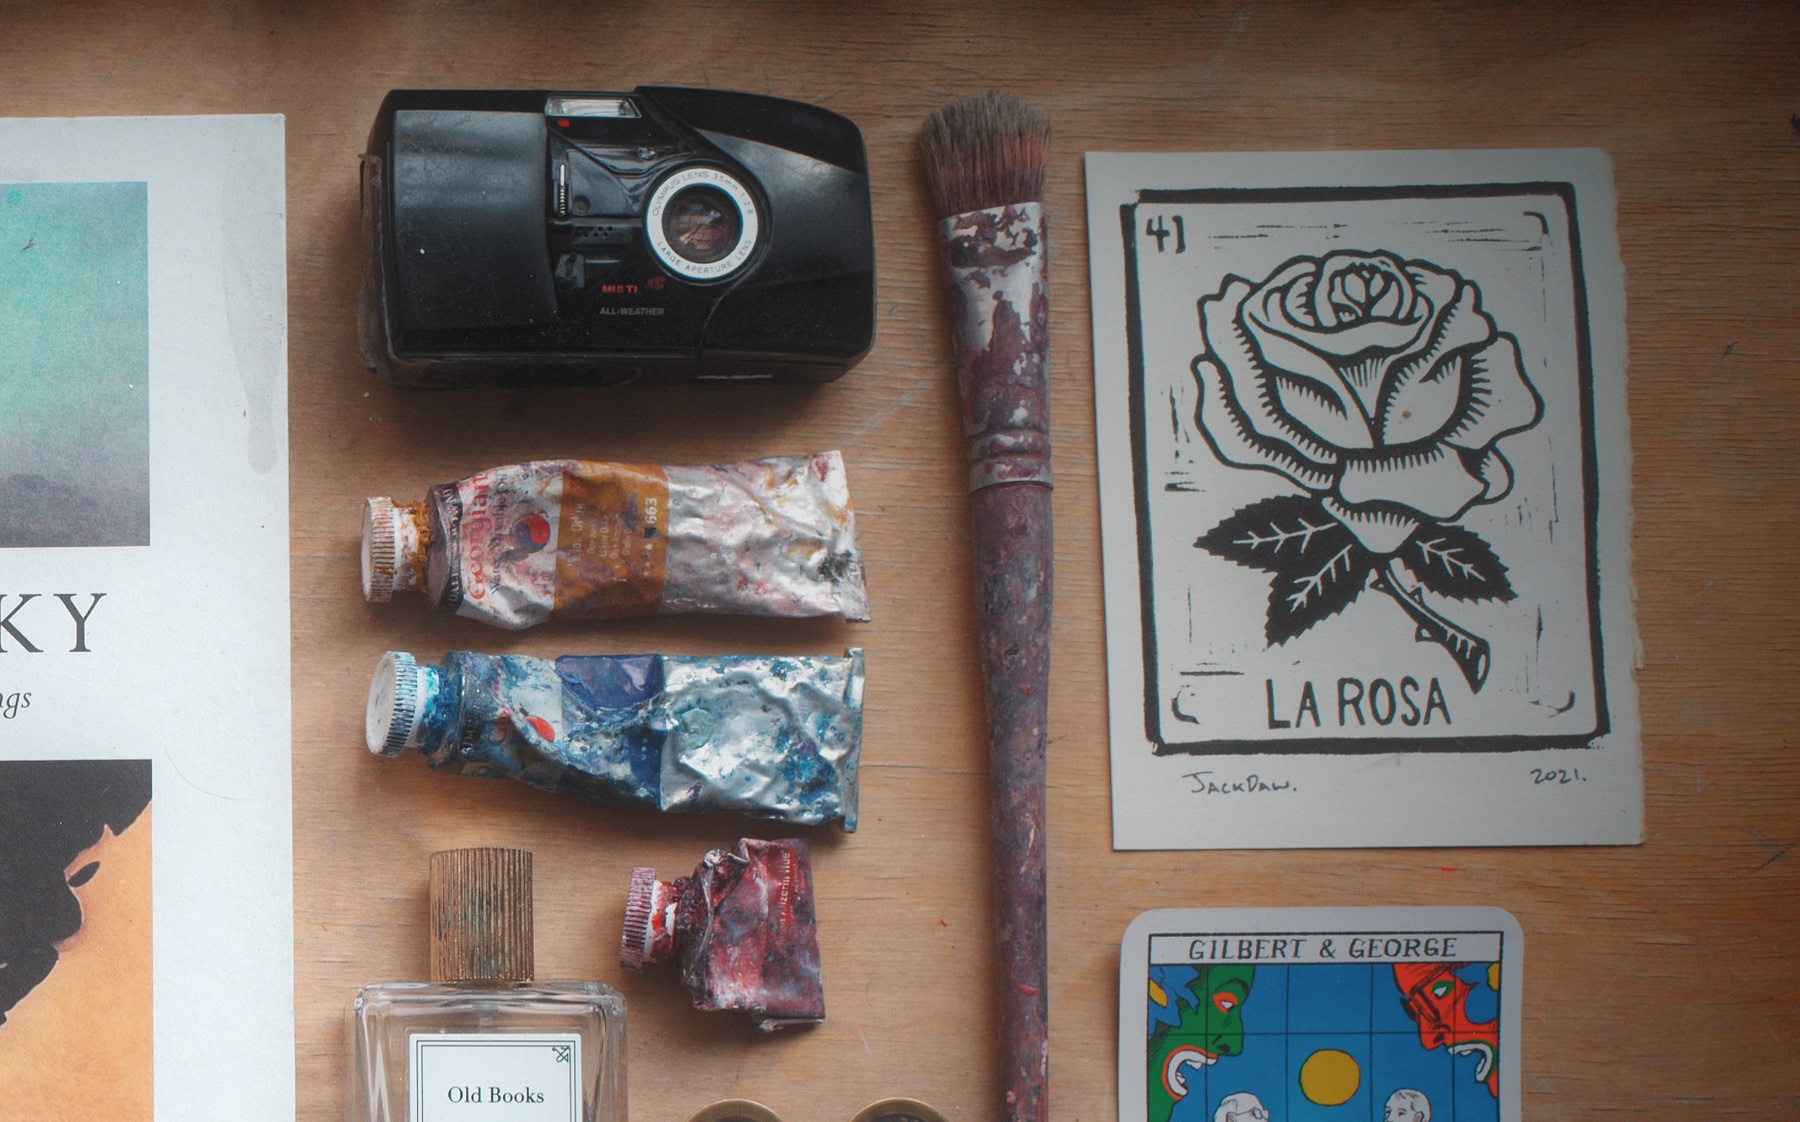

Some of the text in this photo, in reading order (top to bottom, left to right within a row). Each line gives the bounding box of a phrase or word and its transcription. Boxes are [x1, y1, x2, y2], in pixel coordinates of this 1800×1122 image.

[653, 178, 680, 216] OLYMPUS
[682, 171, 708, 181] LENS
[658, 239, 752, 274] LARGE APERTURE LENS
[600, 307, 664, 316] ALL-WEATHER
[644, 498, 657, 524] 663
[468, 475, 491, 600] Georgian
[1266, 676, 1452, 728] LA ROSA
[1189, 937, 1457, 960] GILBERT & GEORGE
[448, 1086, 545, 1103] Old Books
